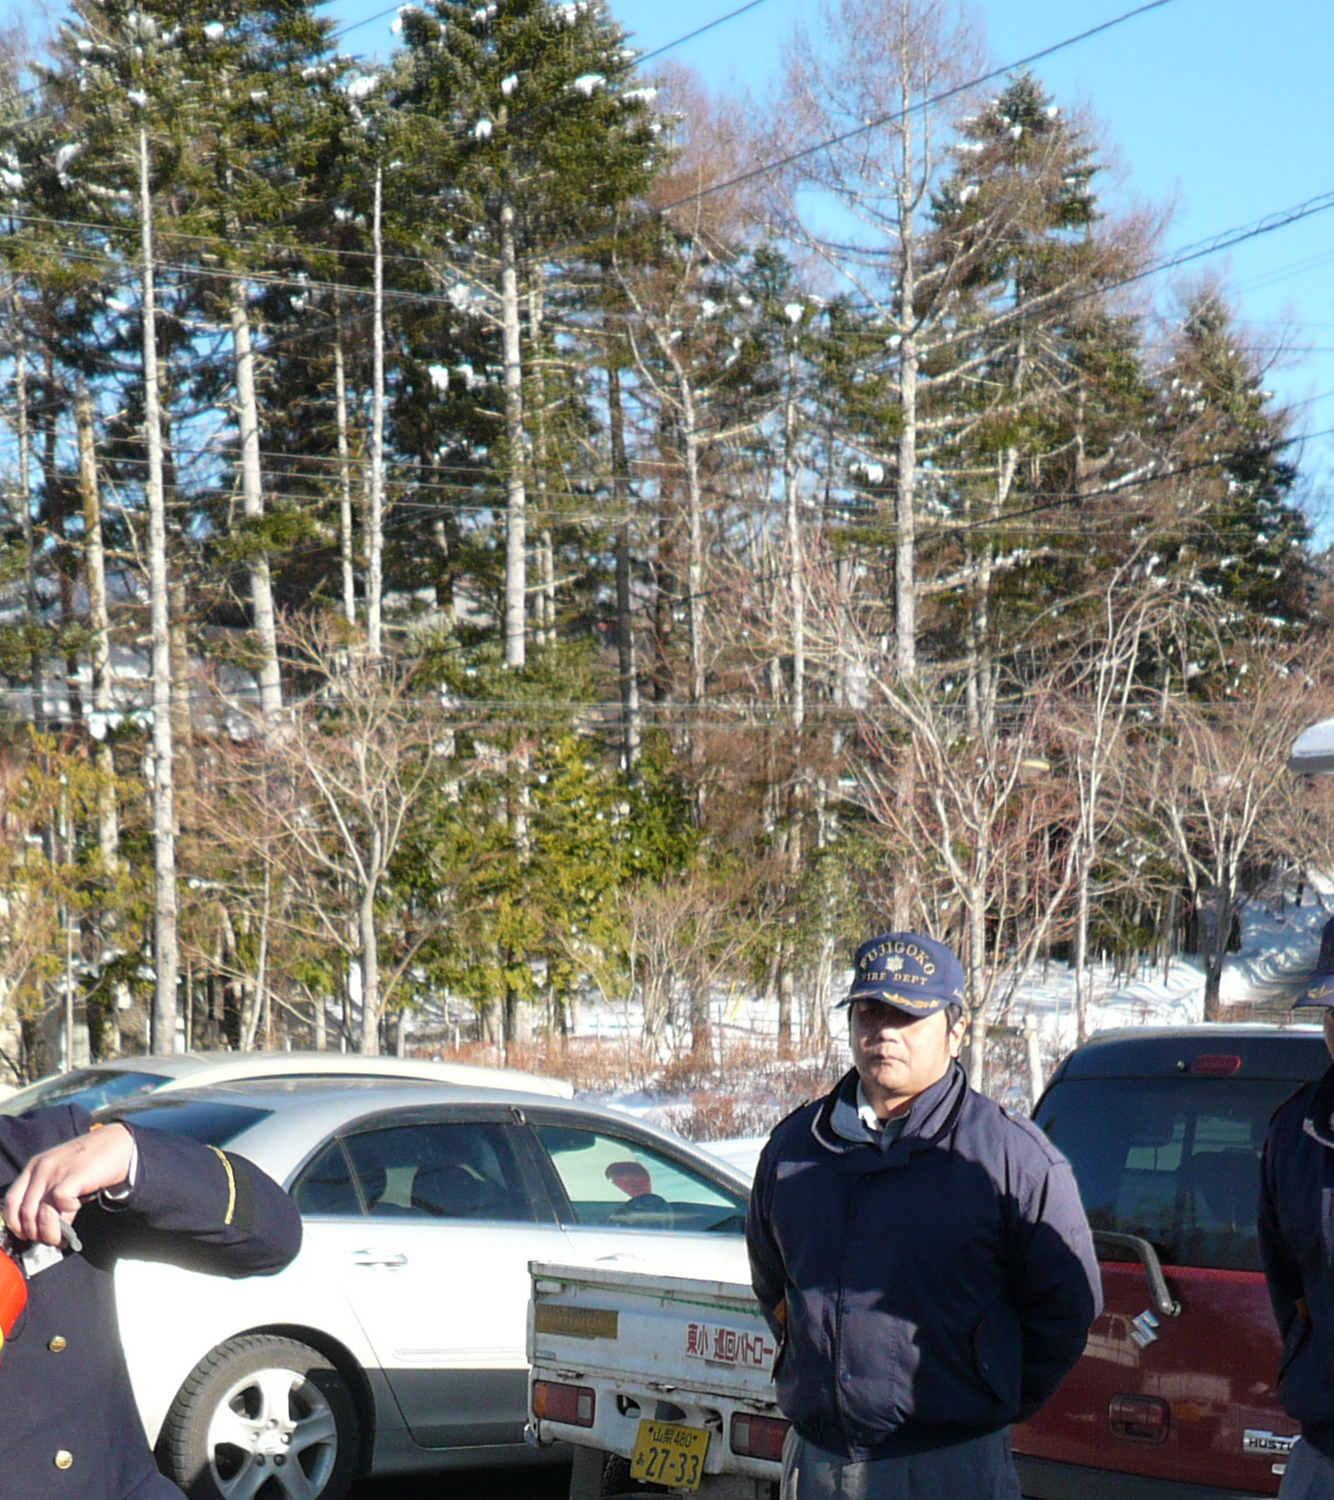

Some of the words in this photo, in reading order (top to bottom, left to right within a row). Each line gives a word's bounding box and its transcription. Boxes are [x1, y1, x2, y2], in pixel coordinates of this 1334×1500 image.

[860, 941, 936, 975] FUJIGOKO
[893, 973, 928, 986] DEPT
[687, 1323, 708, 1356] 東小
[645, 1446, 699, 1485] 27-33
